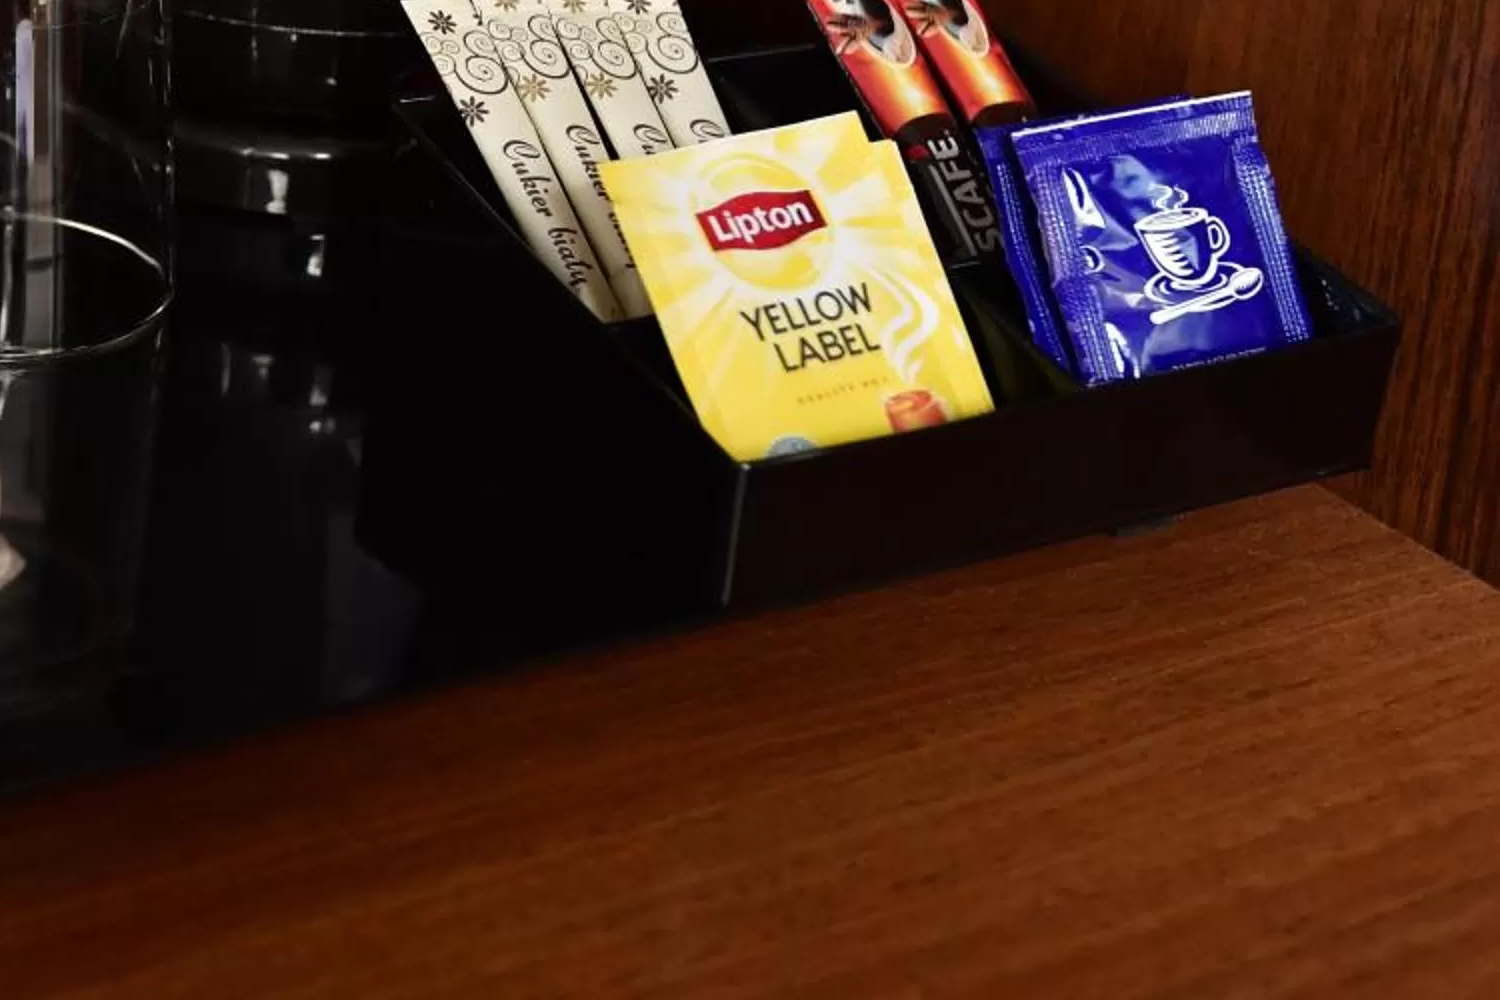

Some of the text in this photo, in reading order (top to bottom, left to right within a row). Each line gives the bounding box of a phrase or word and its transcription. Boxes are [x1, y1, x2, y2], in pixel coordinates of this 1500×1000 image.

[502, 139, 553, 217] Cukier
[707, 201, 815, 244] Lipton
[739, 282, 872, 342] YELLOW
[773, 323, 882, 373] LABEL
